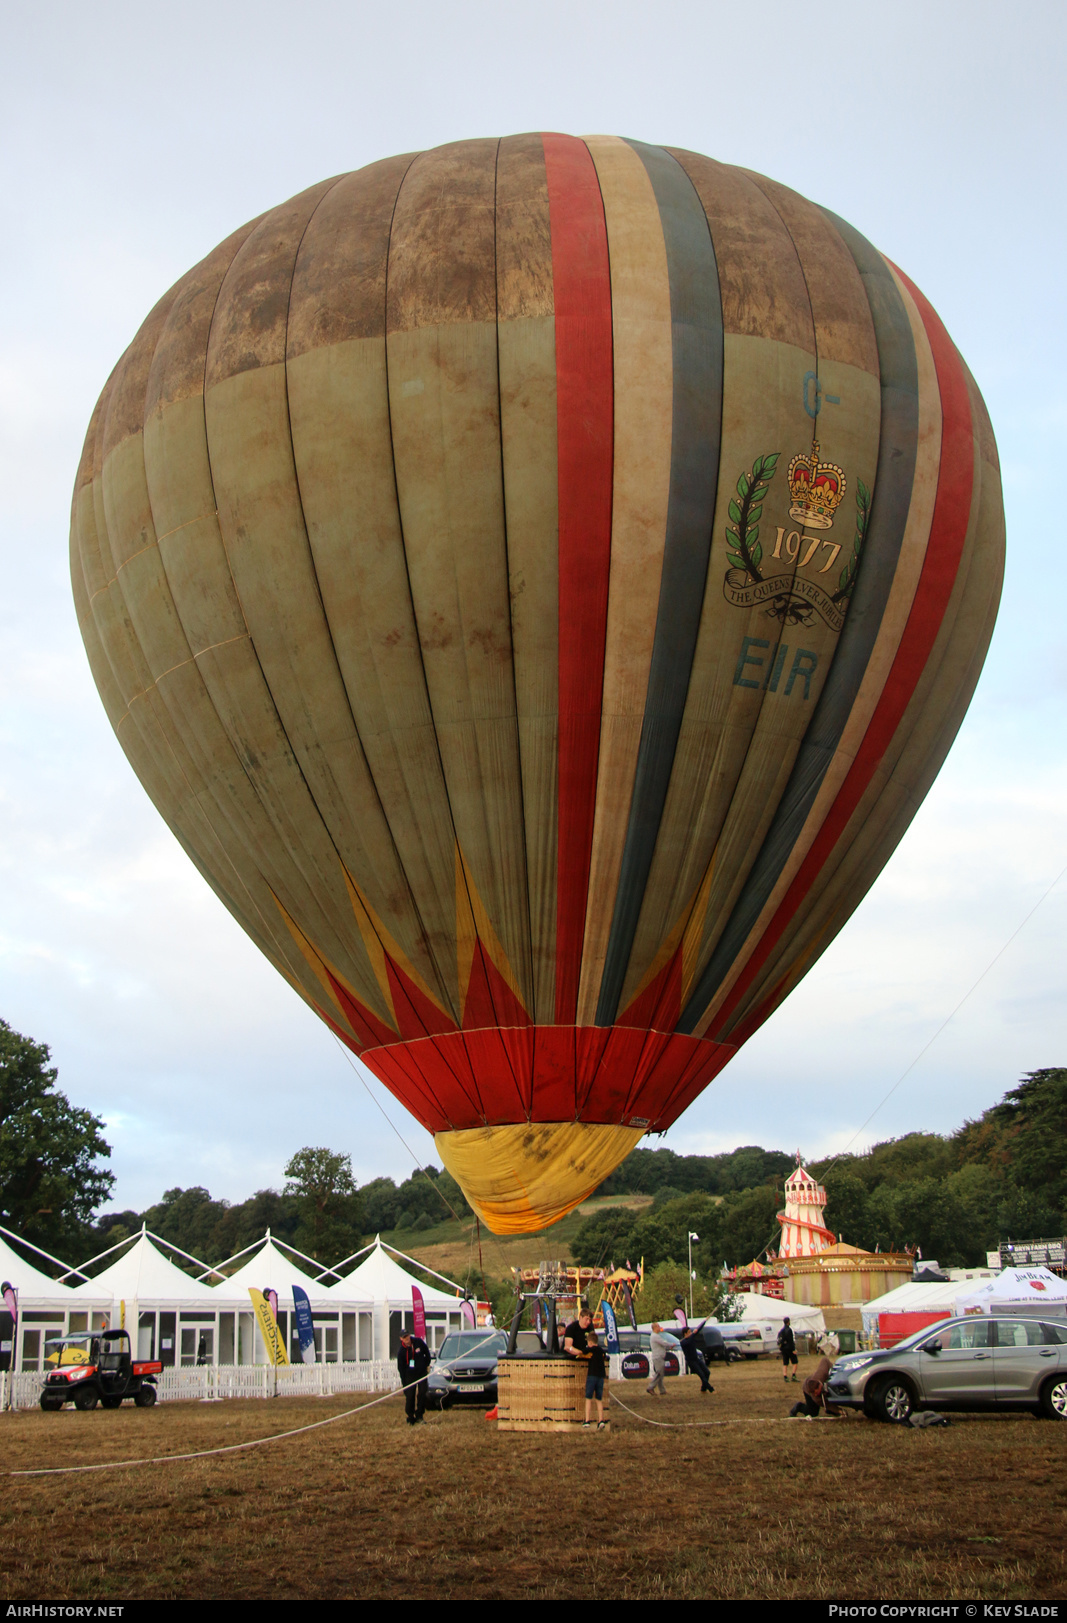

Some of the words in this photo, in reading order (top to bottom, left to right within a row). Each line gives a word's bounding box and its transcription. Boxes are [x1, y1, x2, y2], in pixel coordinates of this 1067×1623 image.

[769, 526, 843, 573] 1977
[730, 590, 752, 603] THE
[792, 581, 820, 600] LVER
[606, 1310, 614, 1341] Omega
